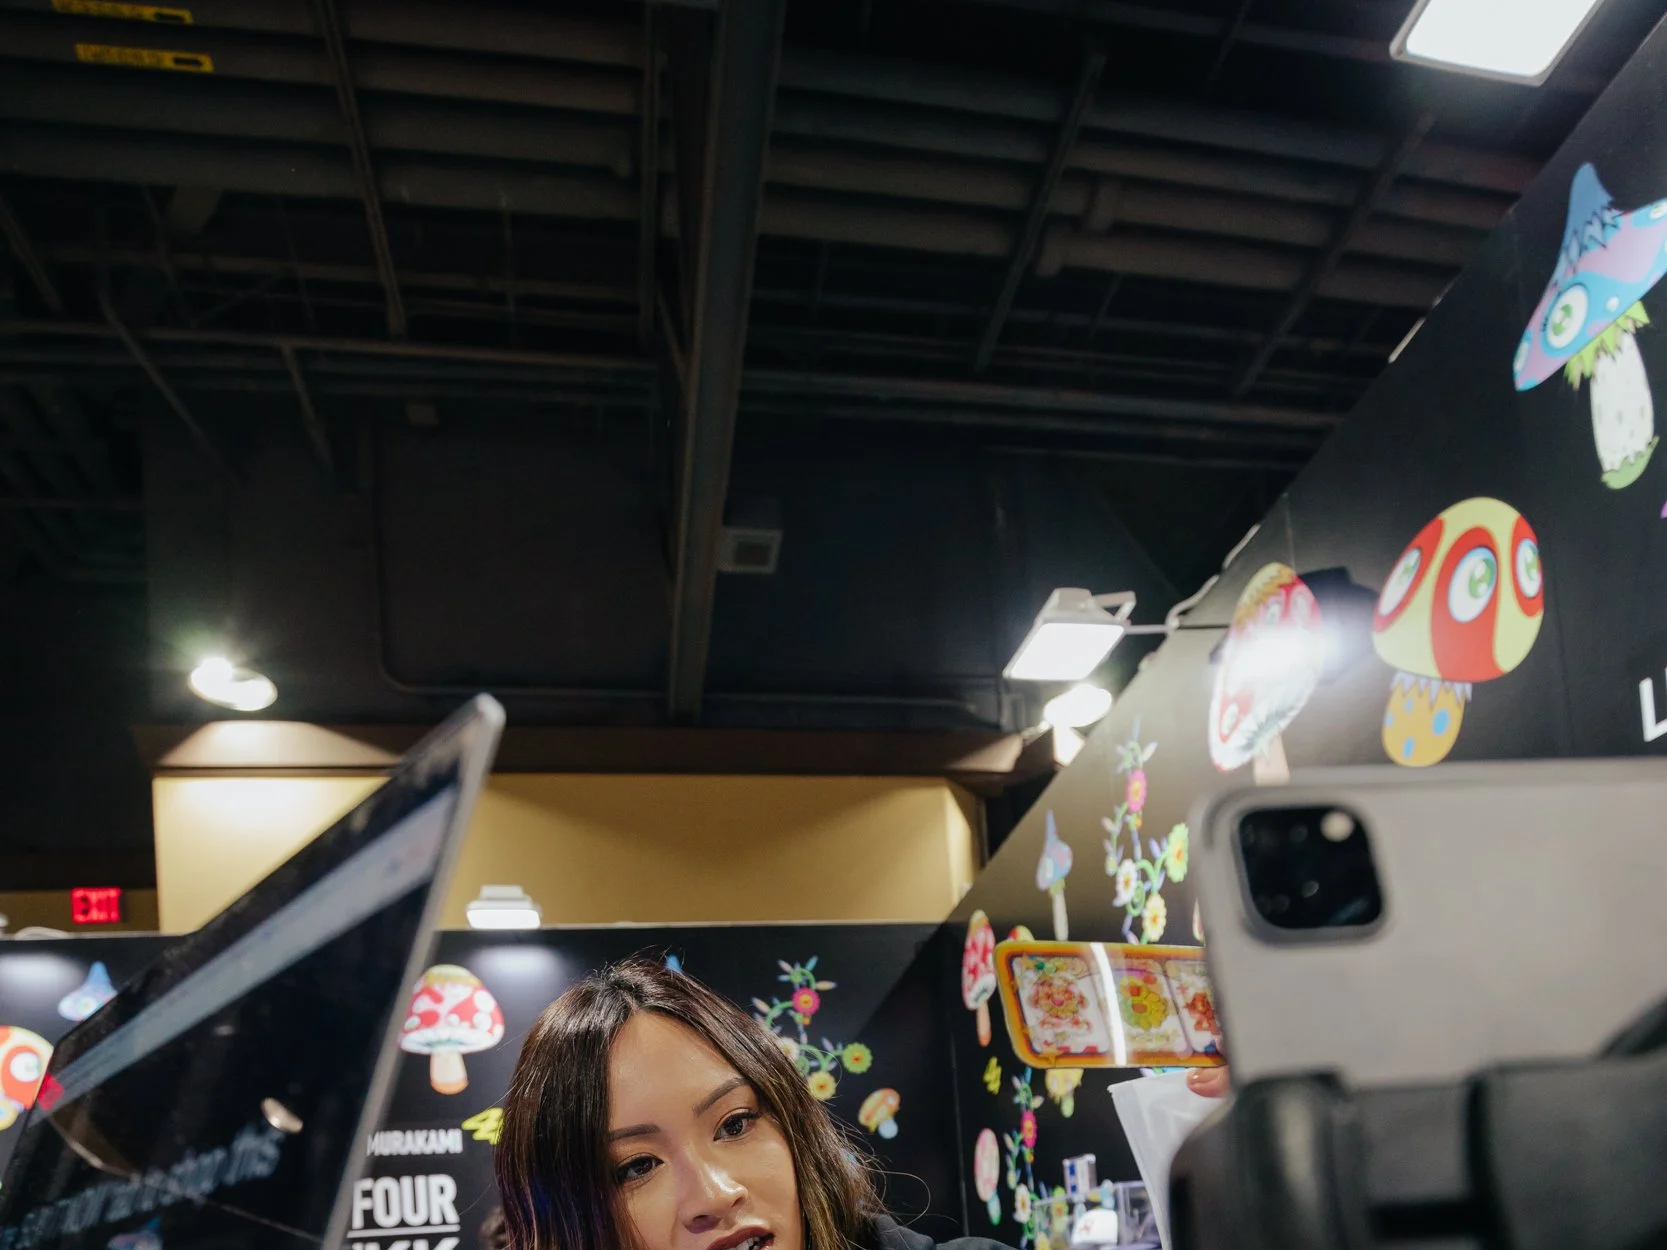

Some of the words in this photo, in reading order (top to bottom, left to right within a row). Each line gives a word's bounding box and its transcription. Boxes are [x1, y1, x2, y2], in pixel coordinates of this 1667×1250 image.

[1639, 666, 1667, 742] L
[72, 887, 122, 923] EXIT
[367, 1128, 463, 1156] MURAKAMI
[351, 1174, 461, 1230] FOUR
